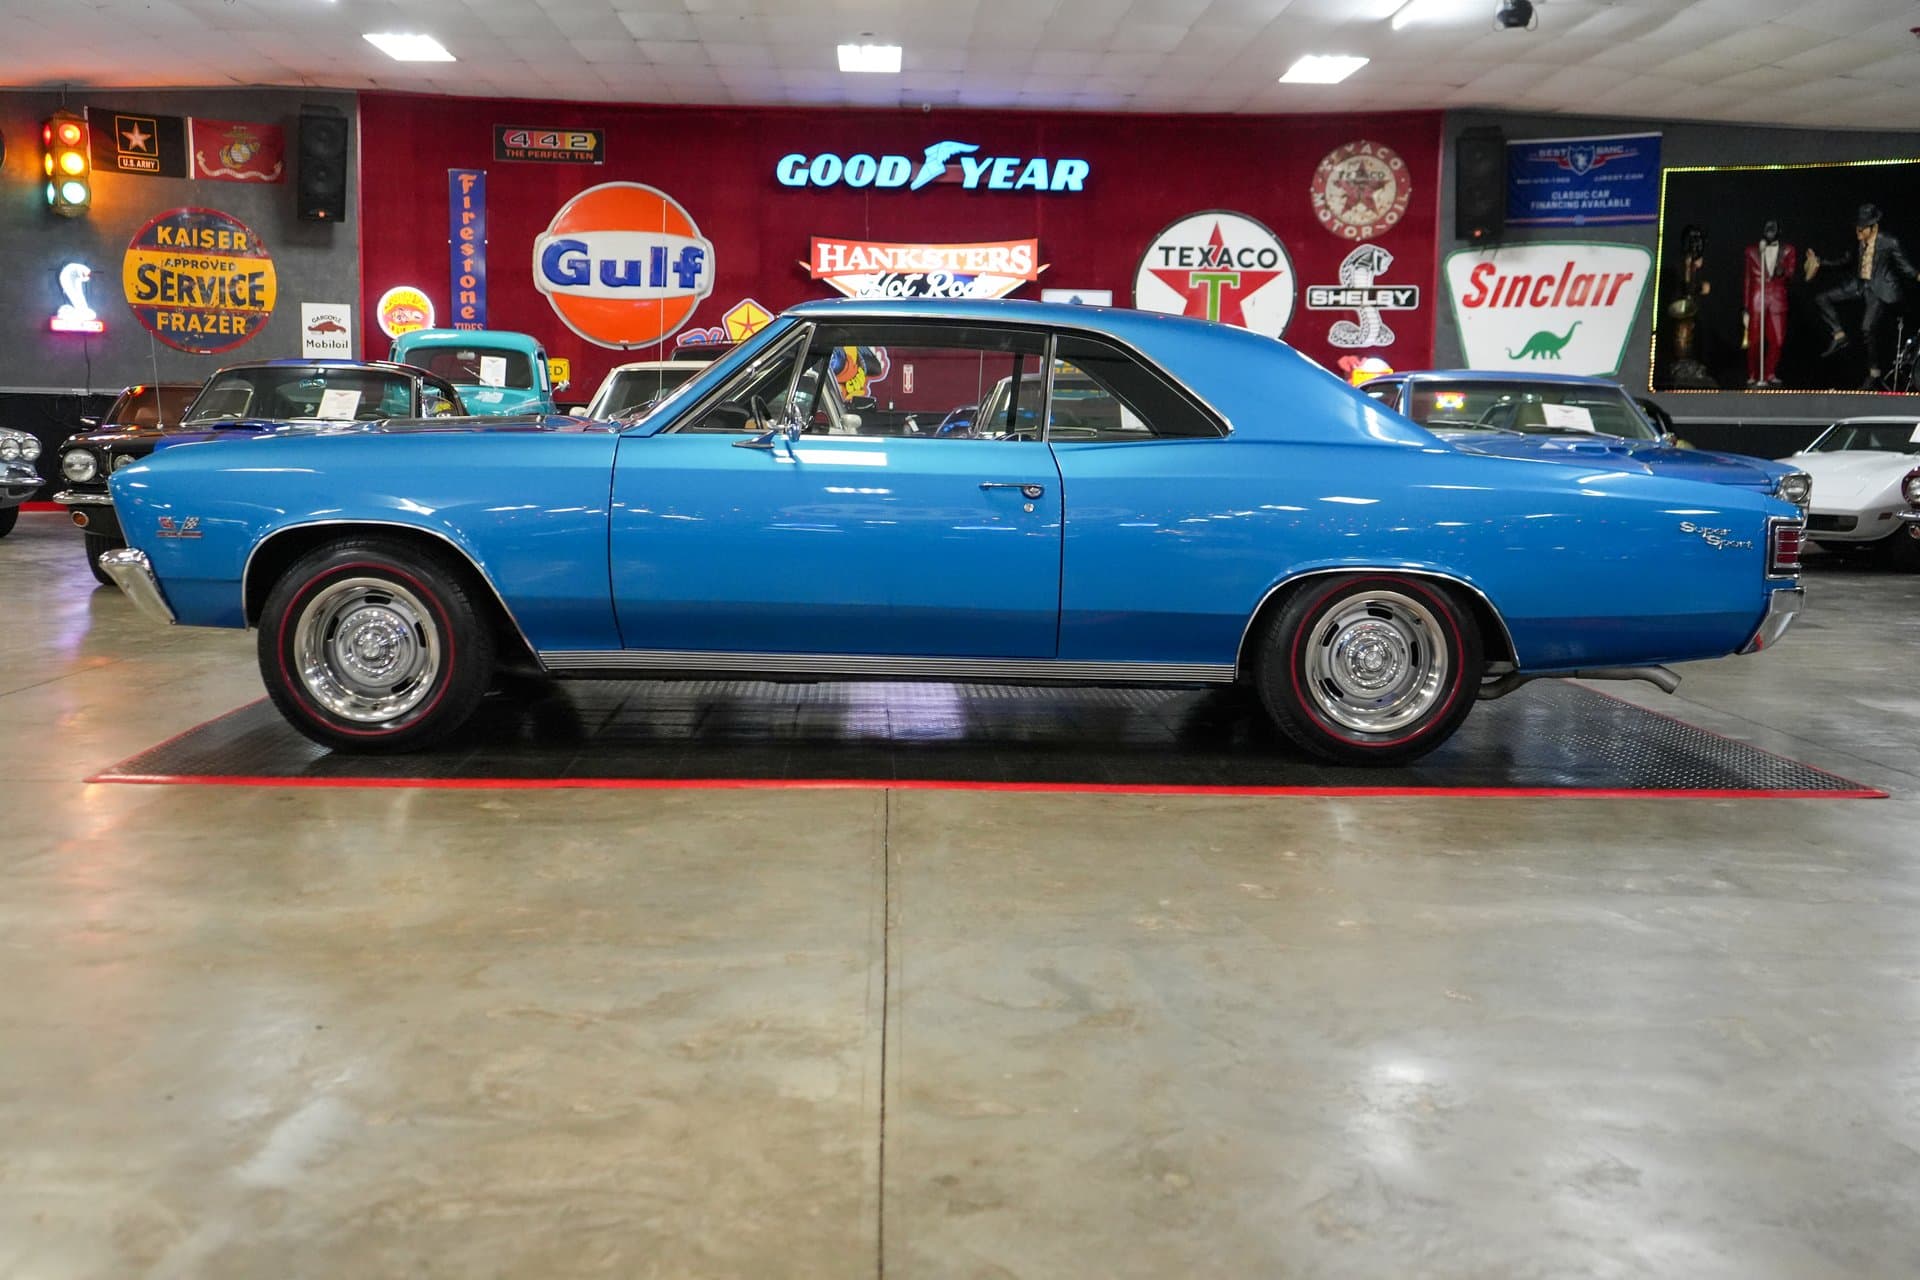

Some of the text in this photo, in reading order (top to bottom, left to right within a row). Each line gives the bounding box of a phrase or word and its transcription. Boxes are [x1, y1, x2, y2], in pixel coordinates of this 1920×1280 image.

[505, 149, 594, 160] THE PERFECT TEN
[136, 160, 155, 169] ARMY
[776, 154, 1090, 191] GOOD YEAR
[1531, 199, 1632, 210] FINANCING AVAILABLE
[1551, 190, 1610, 200] CLASSIC CAR
[157, 225, 248, 251] KAISER
[457, 173, 477, 319] Firestone
[164, 258, 237, 272] APPROVED
[541, 239, 705, 289] Gulf
[817, 243, 1032, 274] HANKSTERS
[1158, 246, 1278, 269] TEXACO
[136, 263, 265, 307] SERVICE
[1462, 261, 1635, 309] Sinclair
[1310, 290, 1413, 306] SHELBY
[156, 311, 247, 335] FRAZER
[306, 340, 348, 349] Mobiloil
[1680, 521, 1732, 537] Super
[1705, 535, 1753, 550] Sport
